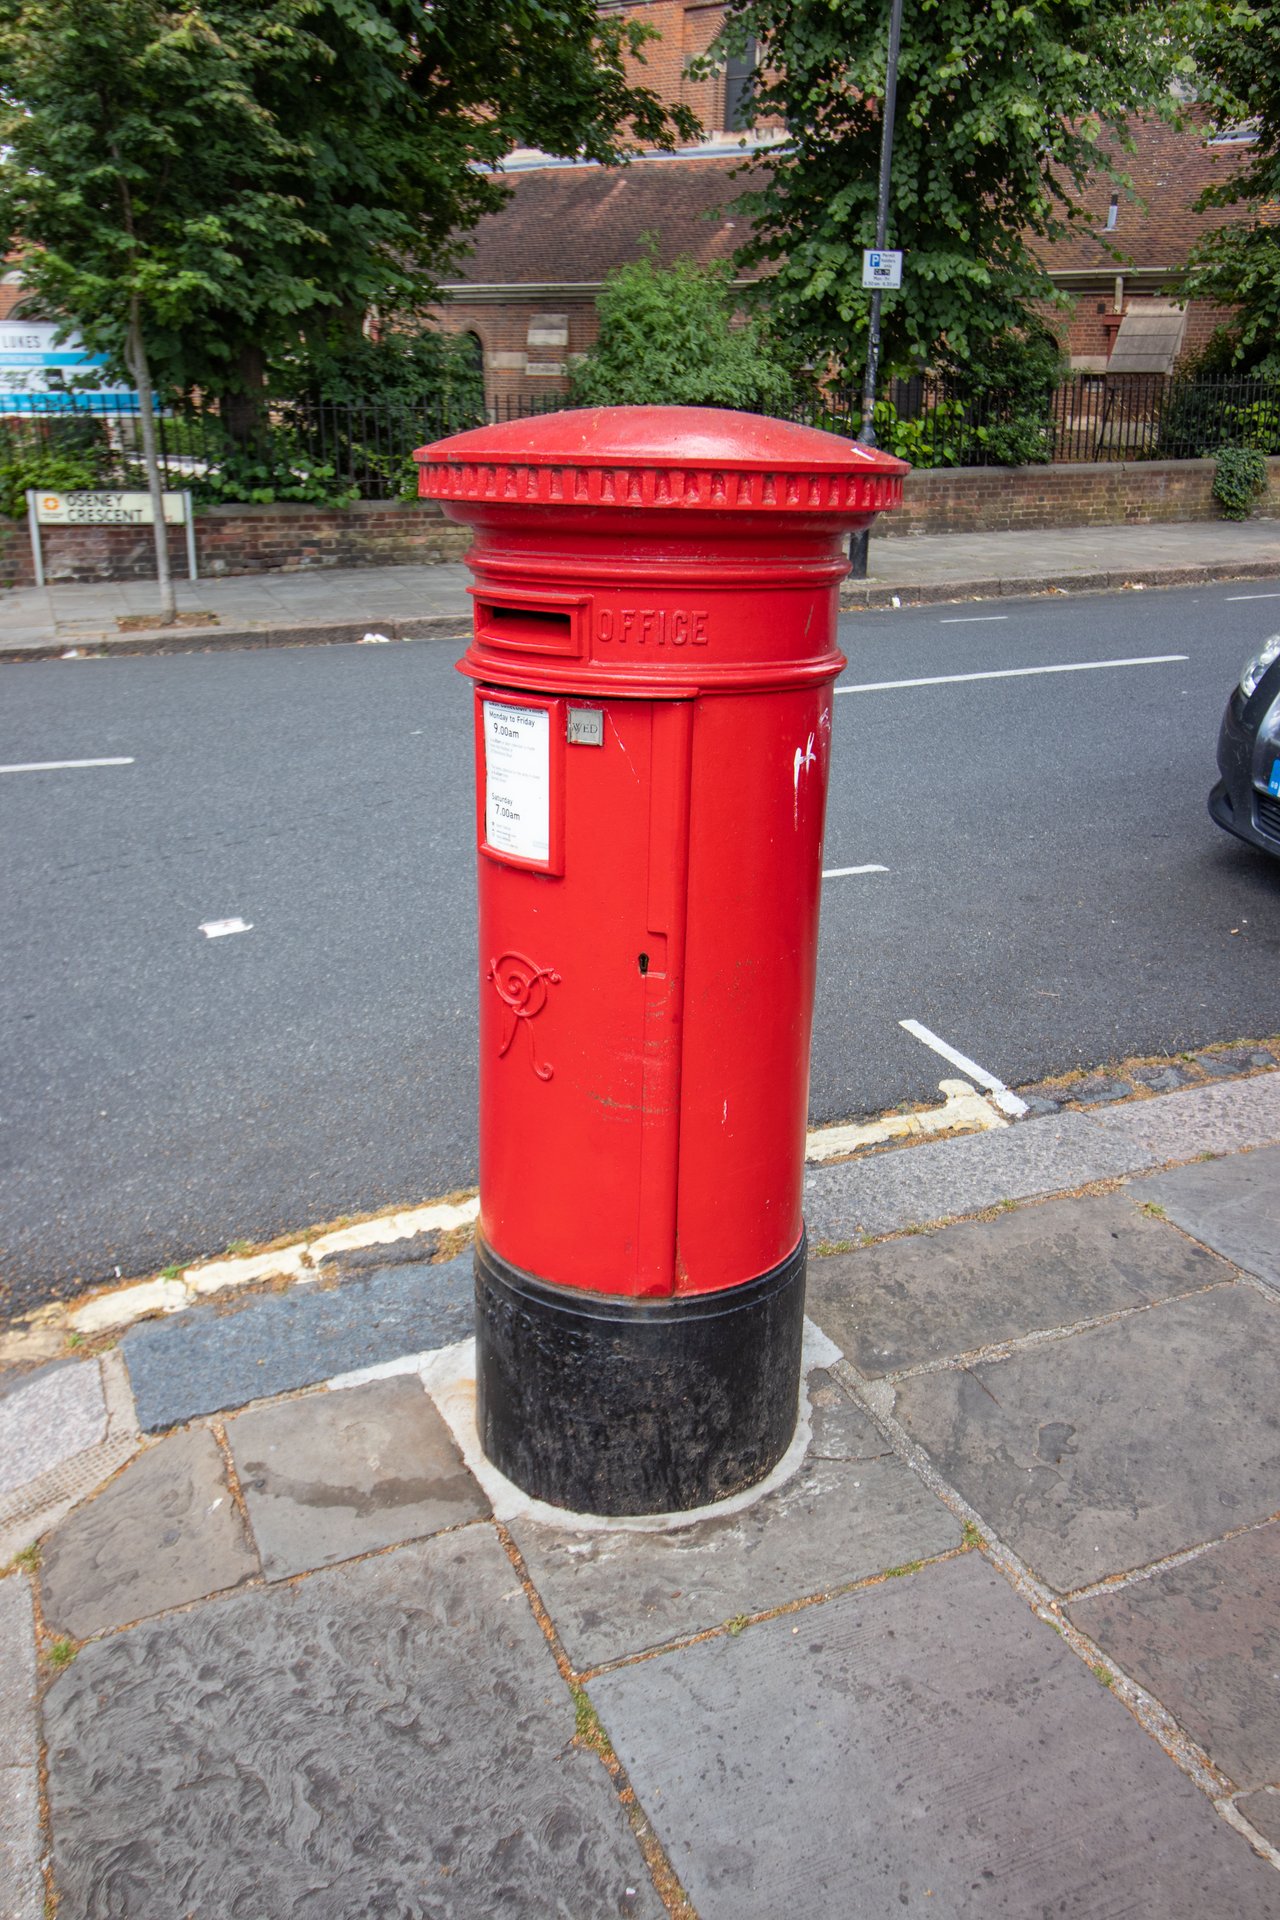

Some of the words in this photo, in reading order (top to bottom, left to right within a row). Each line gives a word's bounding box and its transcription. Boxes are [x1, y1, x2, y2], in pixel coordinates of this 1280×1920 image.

[2, 335, 41, 349] LUKES
[66, 494, 124, 507] OSENEY
[67, 509, 144, 523] CRESCENT
[597, 608, 710, 646] OFFICE
[489, 711, 509, 723] Monday
[510, 715, 515, 723] to
[516, 716, 536, 728] Friday
[493, 722, 520, 739] 9.00am
[572, 722, 599, 735] WED
[491, 792, 513, 806] Saturday
[495, 803, 521, 821] 7.00am
